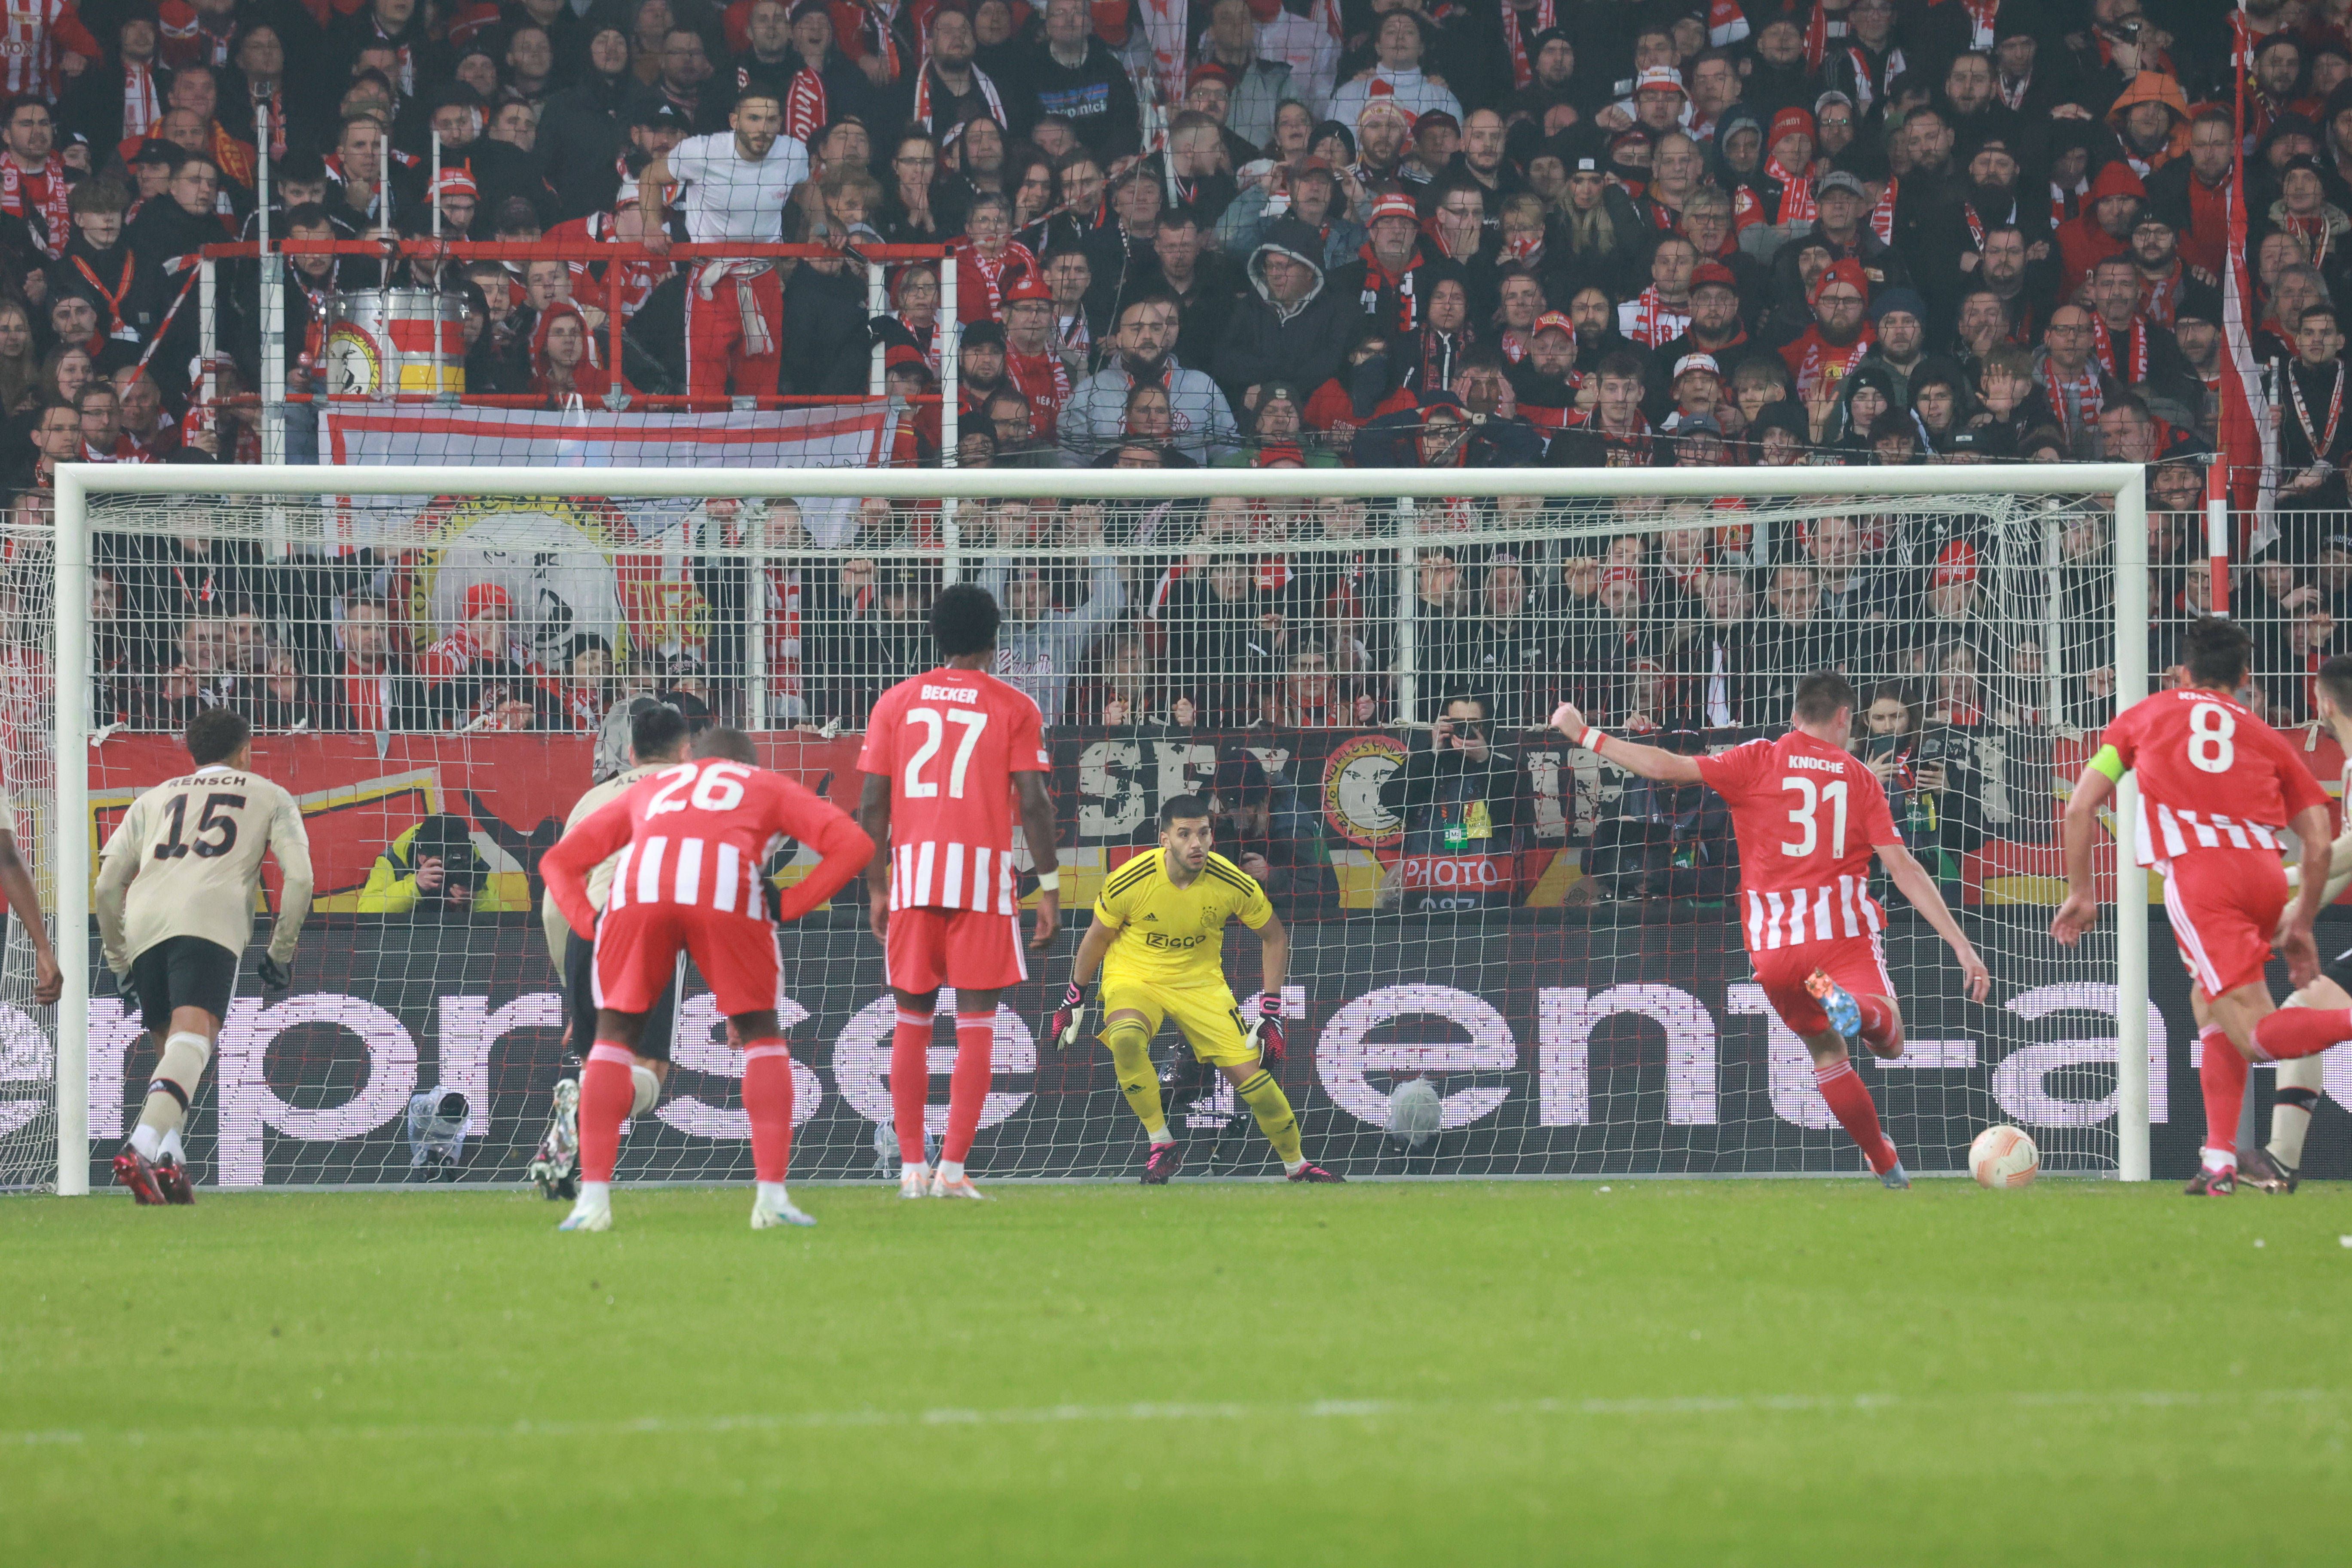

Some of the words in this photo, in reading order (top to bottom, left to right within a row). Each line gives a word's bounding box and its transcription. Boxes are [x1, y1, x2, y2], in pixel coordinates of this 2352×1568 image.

[921, 684, 978, 704] BECKER
[905, 707, 988, 799] 27
[1788, 755, 1844, 773] KNOCHE
[2188, 702, 2236, 773] 8
[168, 776, 246, 788] RENSCH
[645, 763, 751, 821] 26
[154, 793, 247, 861] 15
[1782, 777, 1847, 859] 31
[1405, 861, 1498, 886] PHOTO
